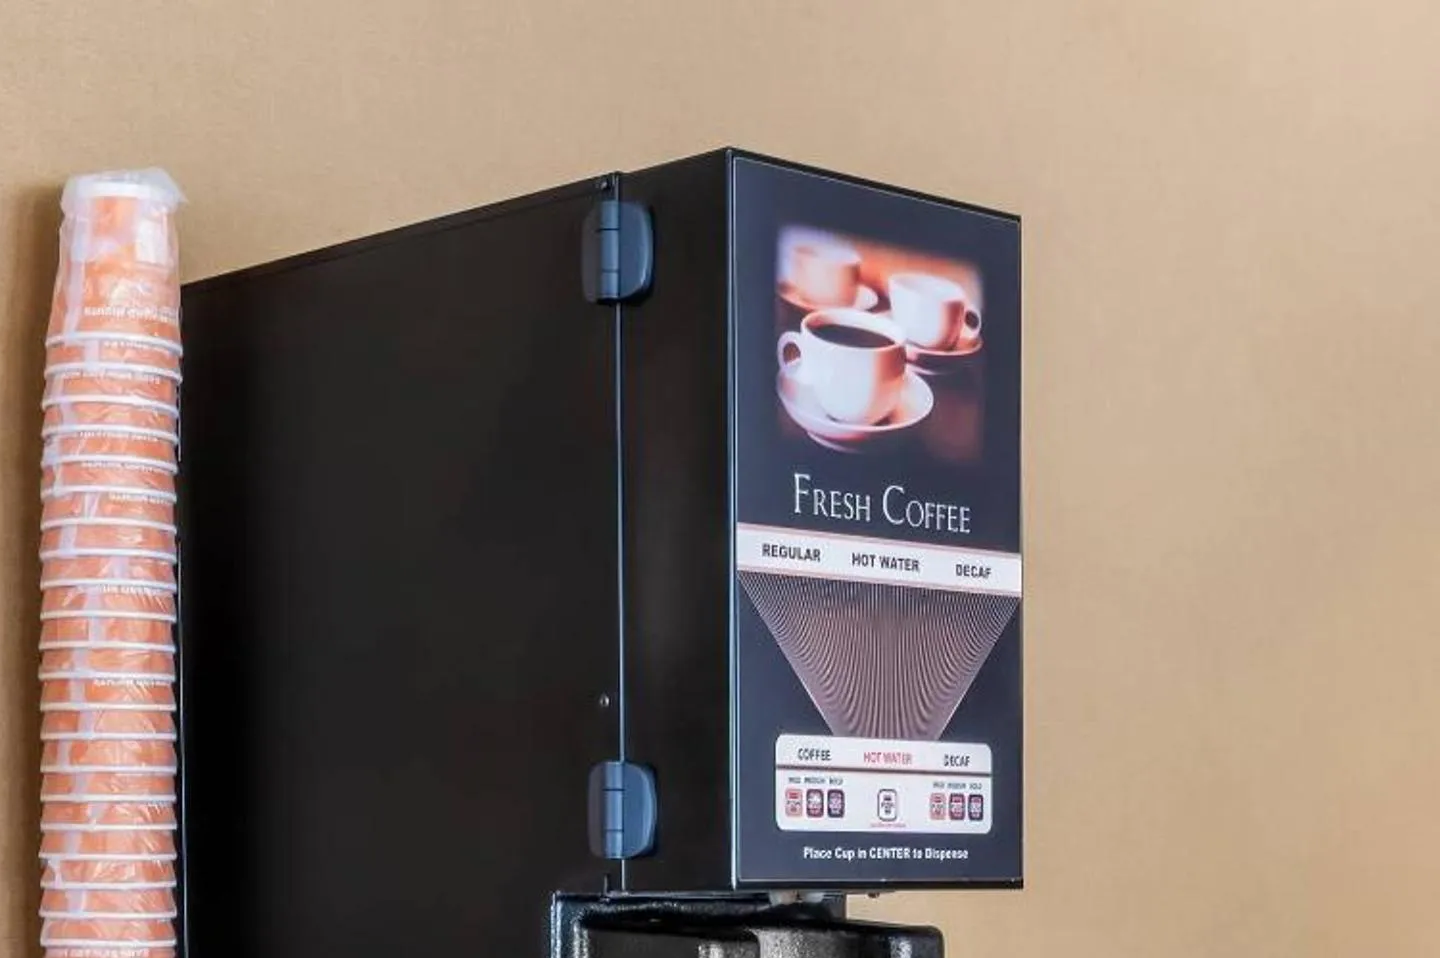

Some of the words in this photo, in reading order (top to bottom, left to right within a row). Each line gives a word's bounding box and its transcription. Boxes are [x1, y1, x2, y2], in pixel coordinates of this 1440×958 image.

[793, 472, 871, 522] FRESH
[882, 485, 971, 534] COFFEE
[761, 542, 821, 562] REGULAR
[851, 552, 875, 568] HOT
[879, 555, 920, 573] WATER
[955, 563, 992, 579] DECAF
[797, 748, 831, 761] COFFEE
[863, 752, 881, 764] HOT
[883, 752, 913, 765] WATER
[944, 754, 971, 767] DECAF
[803, 846, 832, 859] Place
[834, 847, 855, 861] Cup
[857, 847, 867, 859] in
[869, 847, 911, 859] CENTER
[924, 847, 969, 861] Dispense
